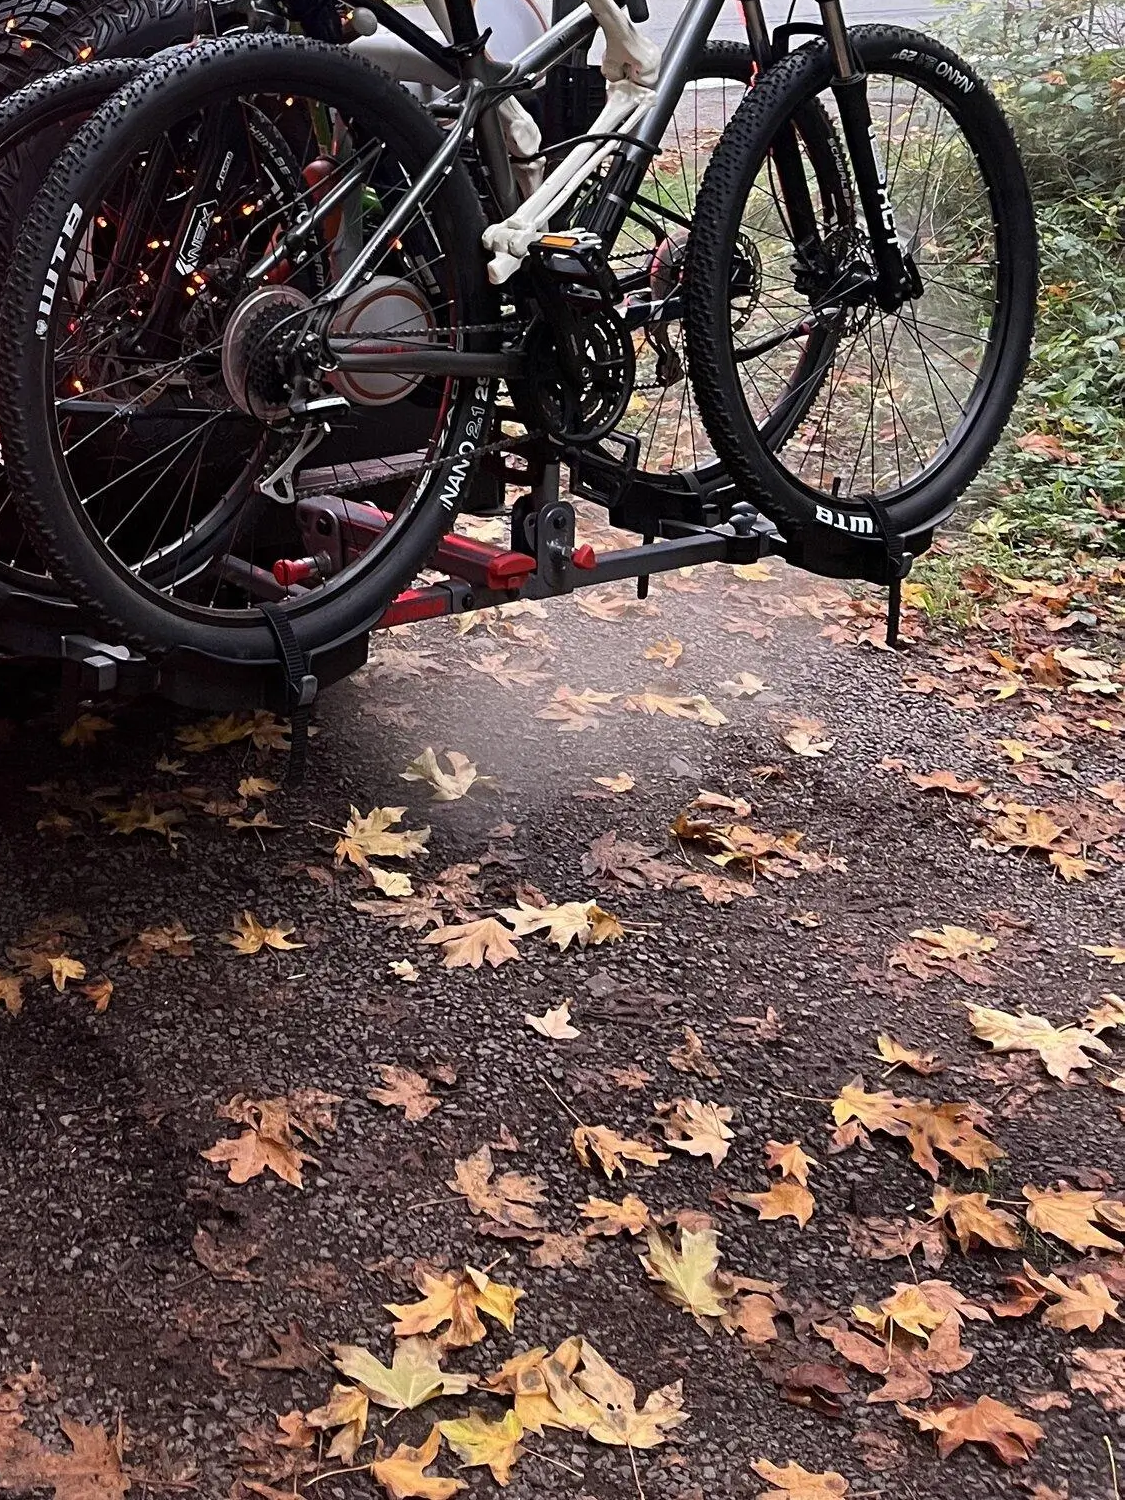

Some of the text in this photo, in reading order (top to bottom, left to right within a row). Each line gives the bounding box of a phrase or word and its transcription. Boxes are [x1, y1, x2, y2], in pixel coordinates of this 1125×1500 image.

[935, 61, 975, 94] NANO
[39, 203, 83, 315] WTB
[187, 207, 215, 259] NEX
[439, 441, 475, 507] NANO
[466, 405, 485, 439] 2.1
[815, 504, 873, 534] WTB
